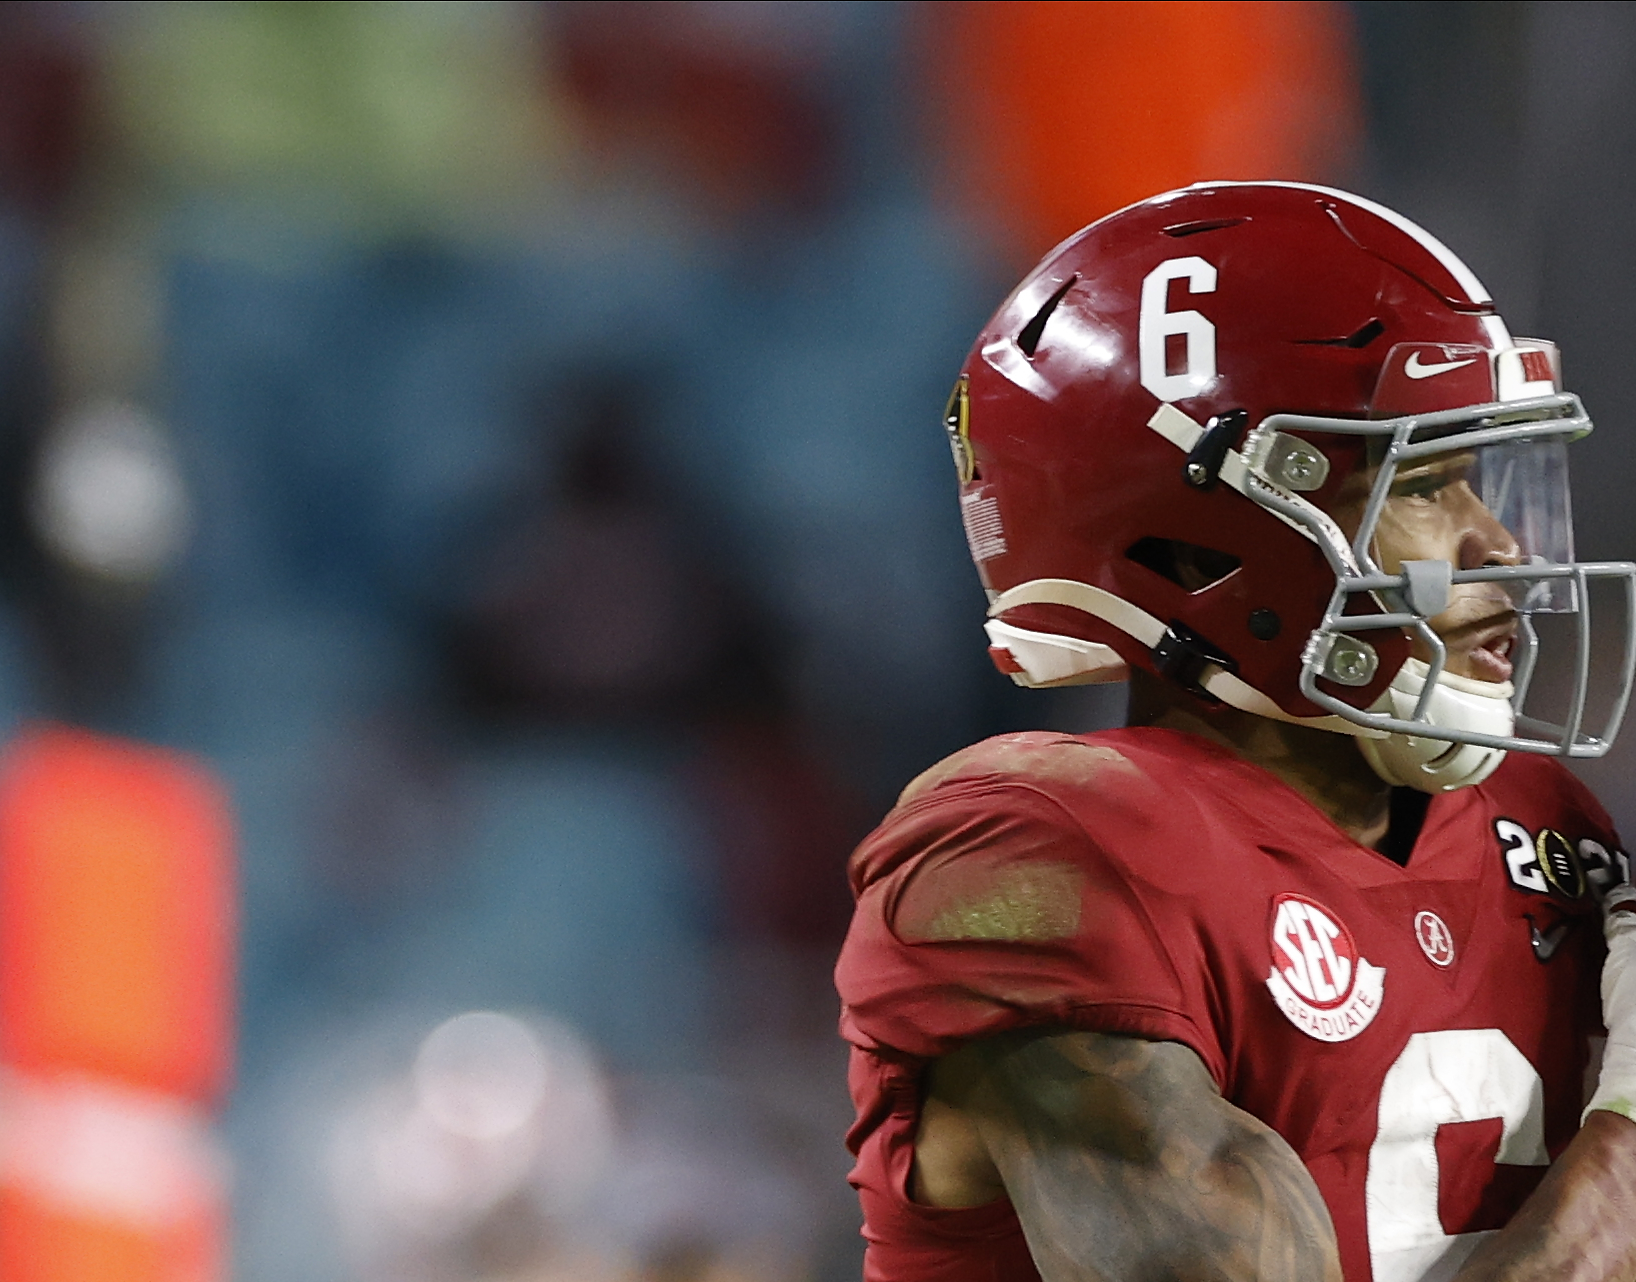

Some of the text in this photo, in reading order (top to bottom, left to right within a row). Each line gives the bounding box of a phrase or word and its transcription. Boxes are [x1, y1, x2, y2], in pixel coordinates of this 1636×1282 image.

[1139, 256, 1218, 403] 6
[1273, 899, 1353, 1002] SEC
[1284, 990, 1377, 1037] GRADUATE
